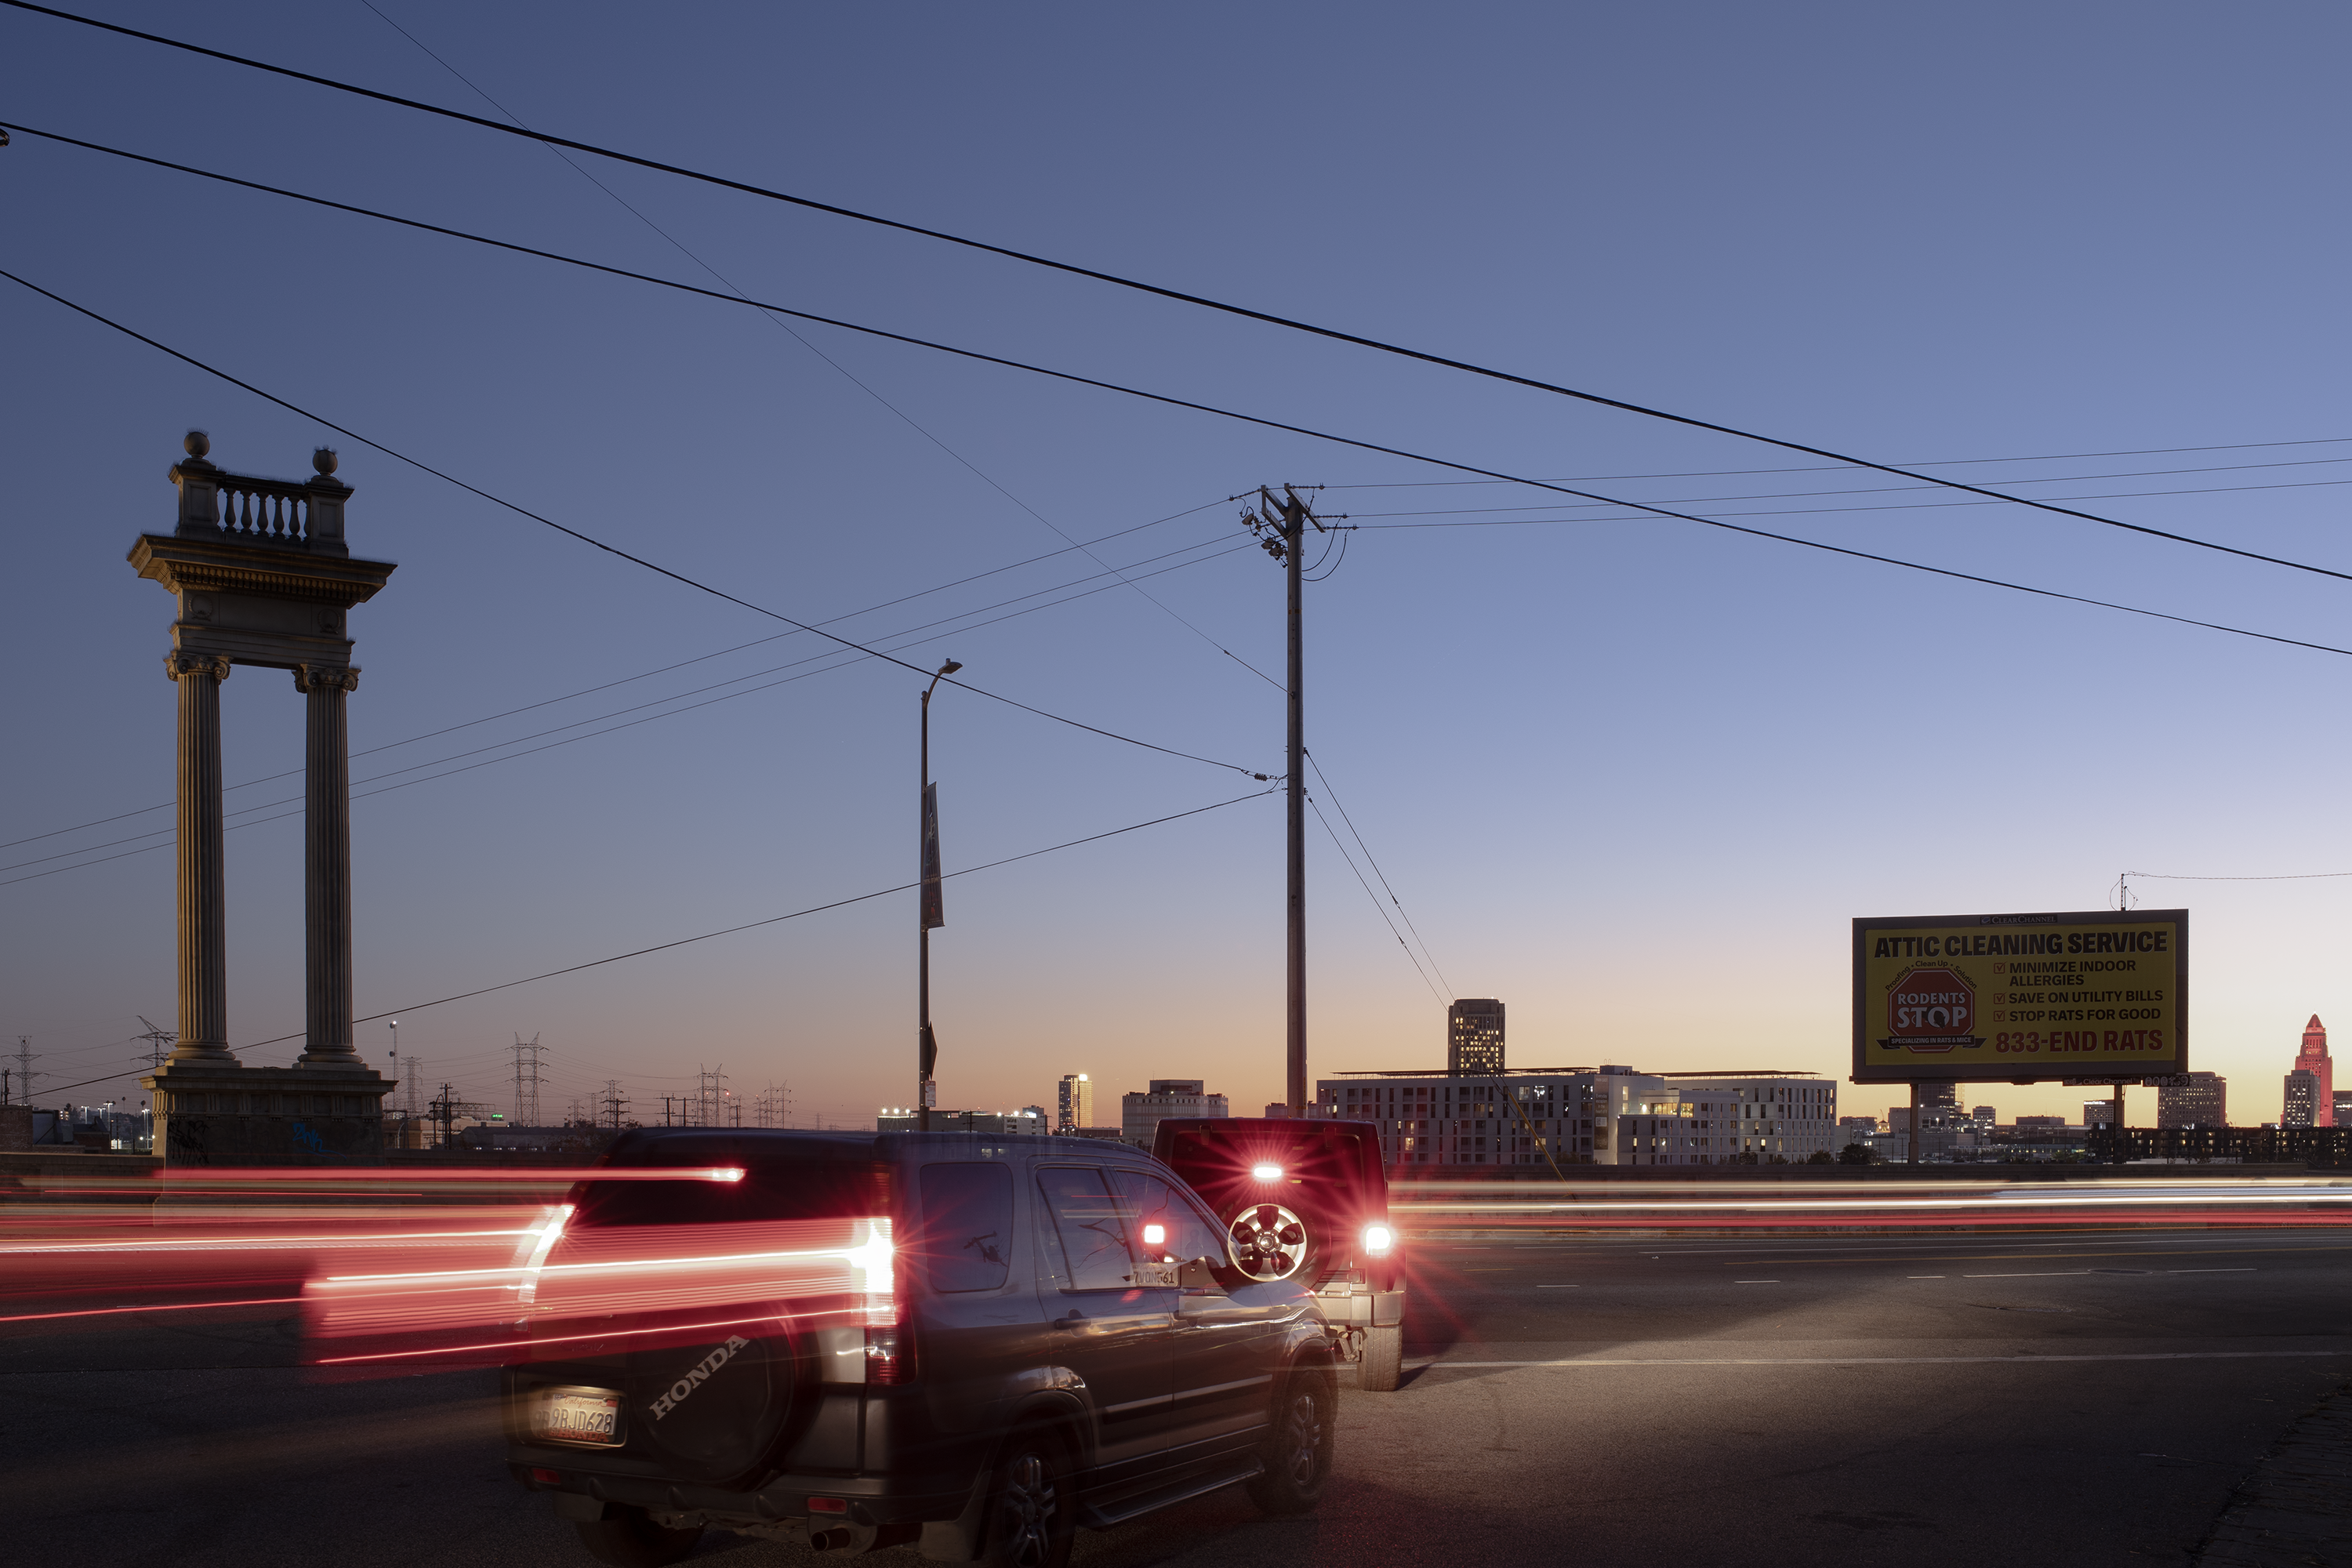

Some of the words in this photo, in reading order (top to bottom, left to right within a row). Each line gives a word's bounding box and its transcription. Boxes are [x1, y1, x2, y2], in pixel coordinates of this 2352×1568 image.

[1875, 936, 1940, 958] ATTIC
[1944, 934, 2063, 957] CLEANING
[2067, 931, 2169, 954] SERVICE
[2009, 961, 2076, 974] MINIMIZE
[2080, 960, 2136, 972] INDOOR
[1885, 966, 1911, 991] Proofing
[1954, 965, 1977, 989] Solution
[2009, 975, 2085, 987] ALLERGIES
[1897, 992, 1965, 1005] RODENTS
[2009, 993, 2045, 1004] SAVE
[2048, 992, 2068, 1003] ON
[2072, 991, 2122, 1003] UTILITY
[2126, 990, 2164, 1002] BILLS
[1897, 1006, 1968, 1029] STOP
[2009, 1011, 2045, 1022] STOP
[2049, 1010, 2084, 1022] RATS
[2087, 1009, 2115, 1021] FOR
[2118, 1008, 2161, 1020] GOOD
[1995, 1031, 2098, 1054] 833-END
[2103, 1029, 2164, 1052] RATS
[648, 1334, 750, 1421] HONDA
[564, 1395, 608, 1409] California
[552, 1406, 613, 1433] 9BJD628
[557, 1428, 609, 1443] HONDA
